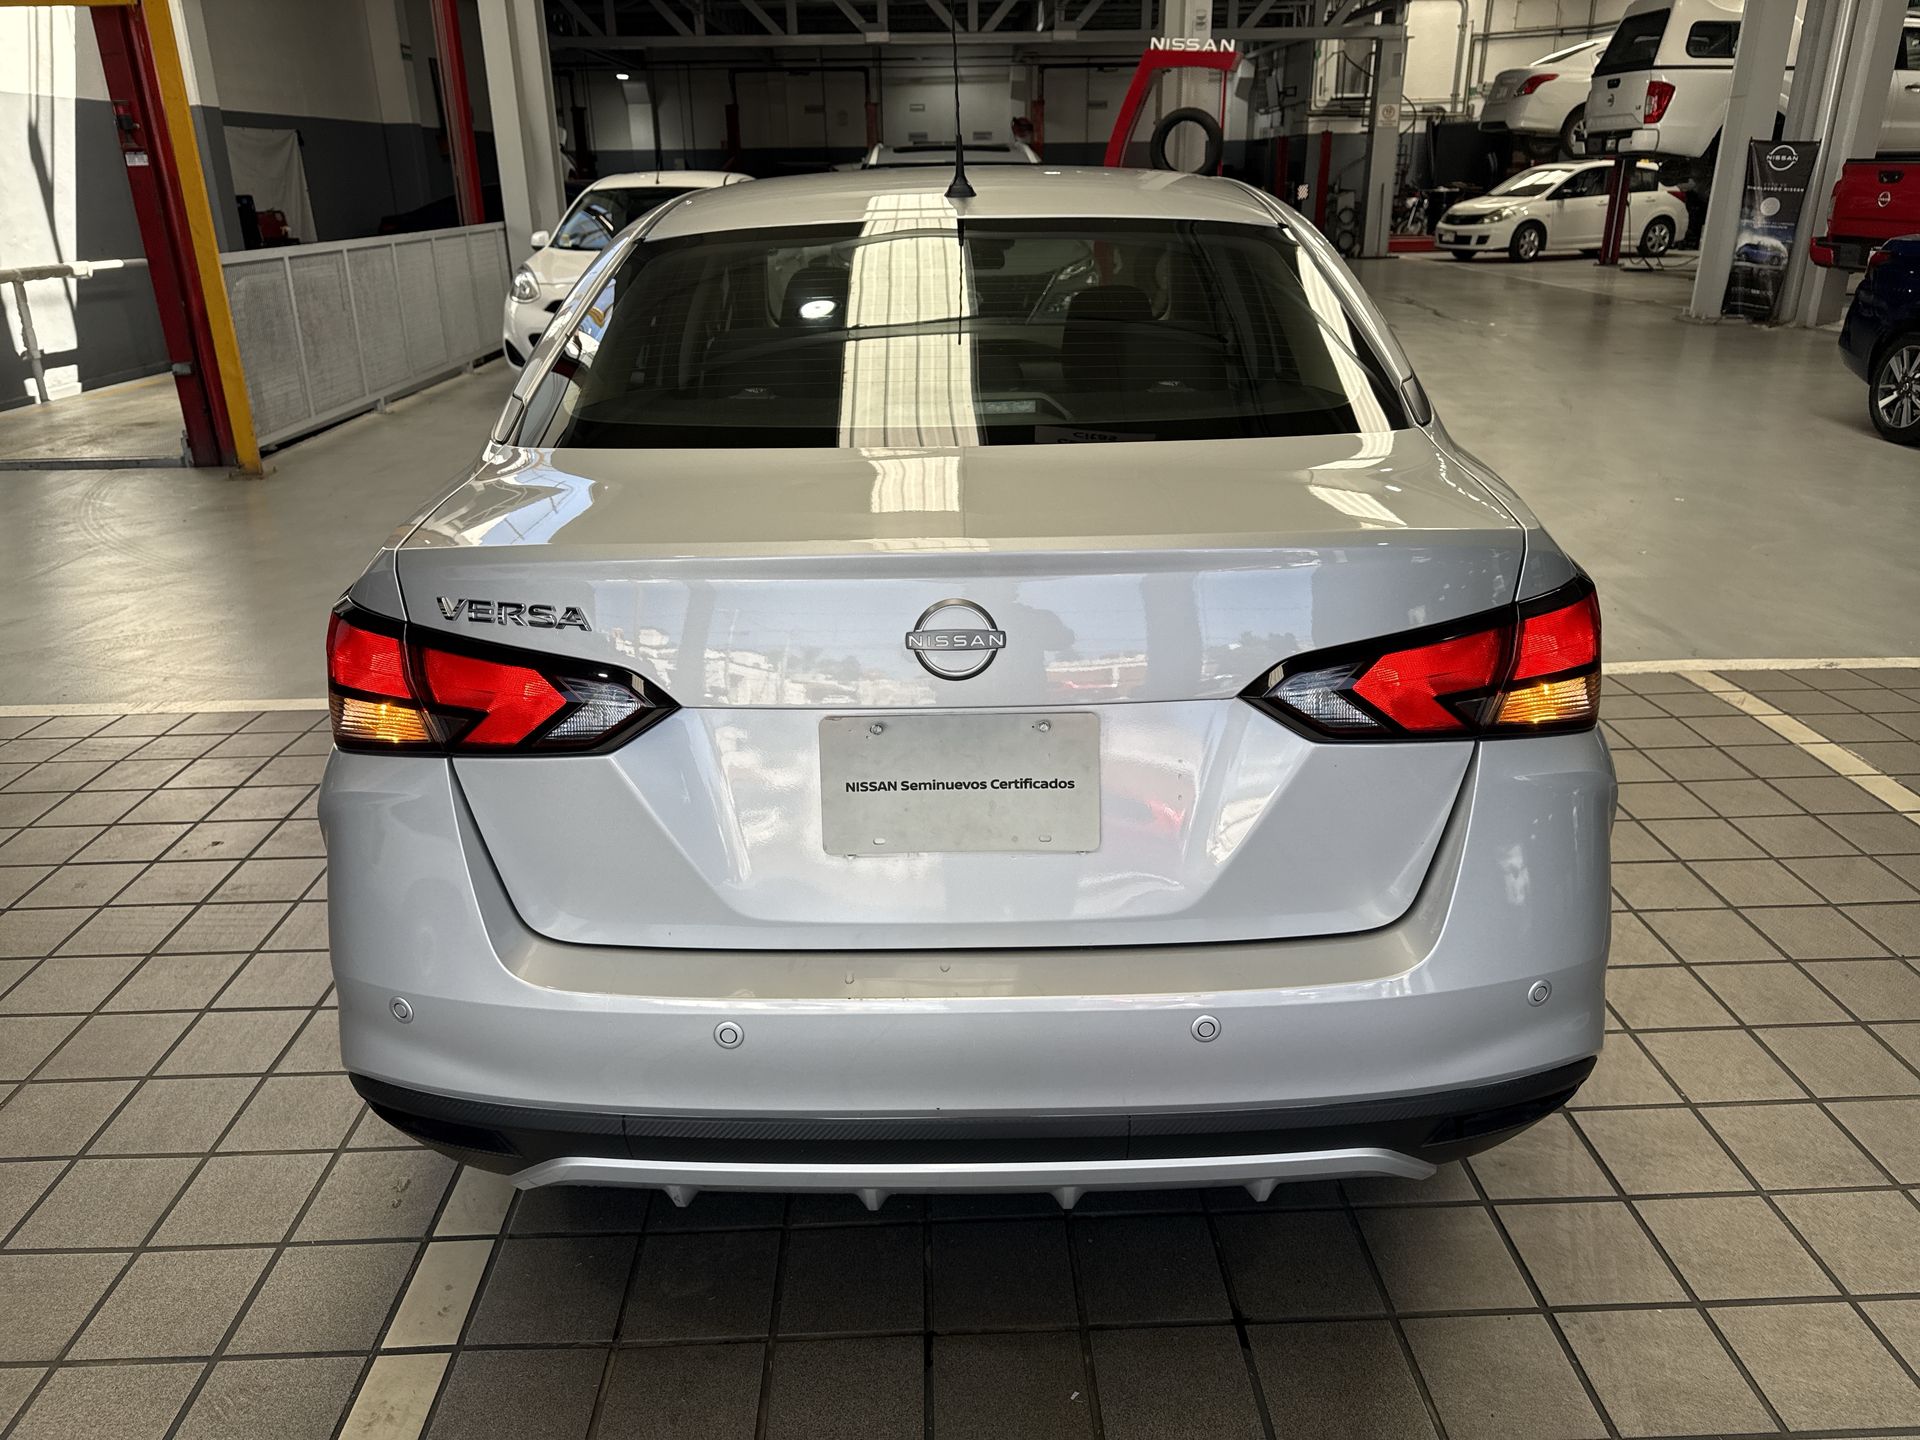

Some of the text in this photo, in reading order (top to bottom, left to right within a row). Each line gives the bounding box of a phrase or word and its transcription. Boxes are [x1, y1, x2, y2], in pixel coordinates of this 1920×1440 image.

[1150, 37, 1235, 52] NISSAN
[436, 596, 592, 632] VERSA
[908, 634, 1003, 647] NISSAN
[845, 778, 1075, 792] NISSAN Seminuevos Certificados
